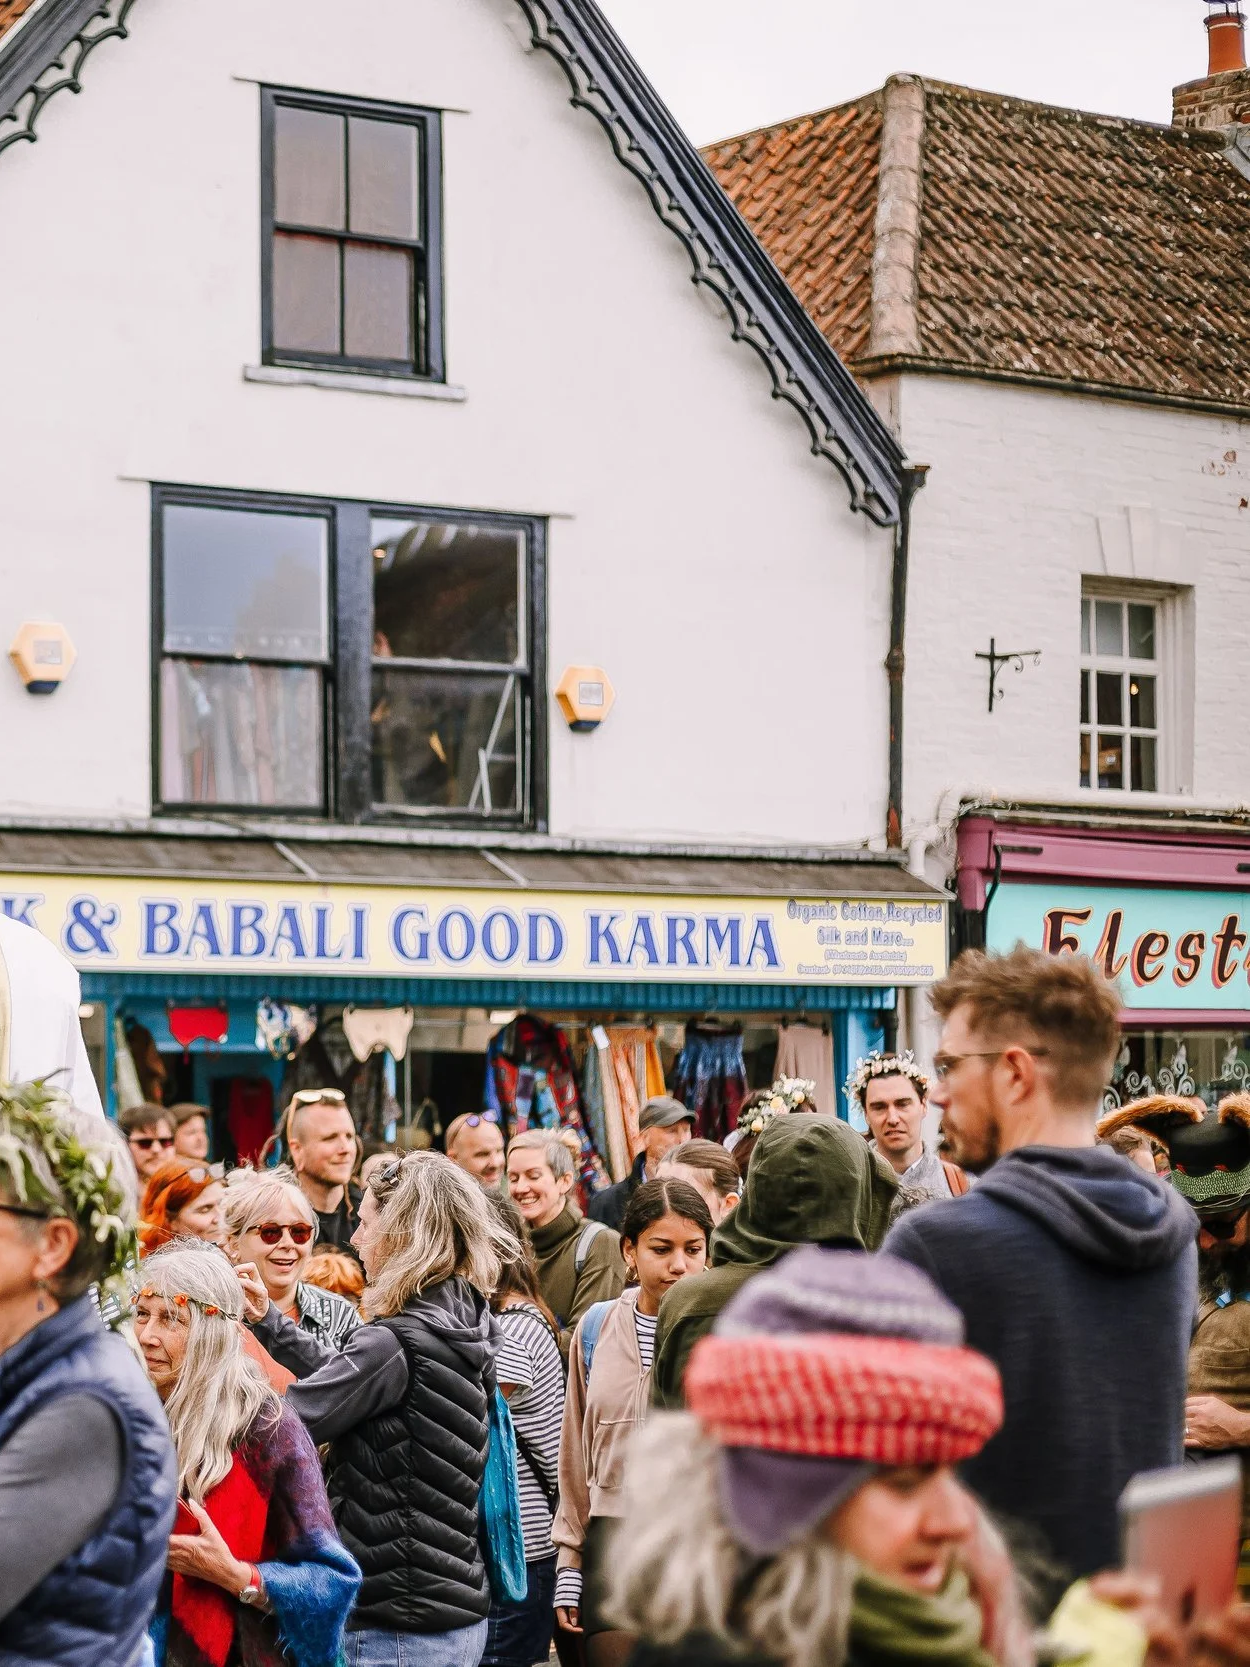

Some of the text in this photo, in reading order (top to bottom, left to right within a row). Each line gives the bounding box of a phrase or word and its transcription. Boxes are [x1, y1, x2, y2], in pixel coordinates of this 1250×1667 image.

[64, 898, 118, 955] &
[142, 901, 368, 960] BABALI
[391, 909, 565, 964] GOOD
[586, 912, 781, 968] KARMA
[788, 899, 837, 924] Organic
[817, 926, 841, 945] Silk
[845, 927, 868, 945] and
[1044, 906, 1250, 989] Elest
